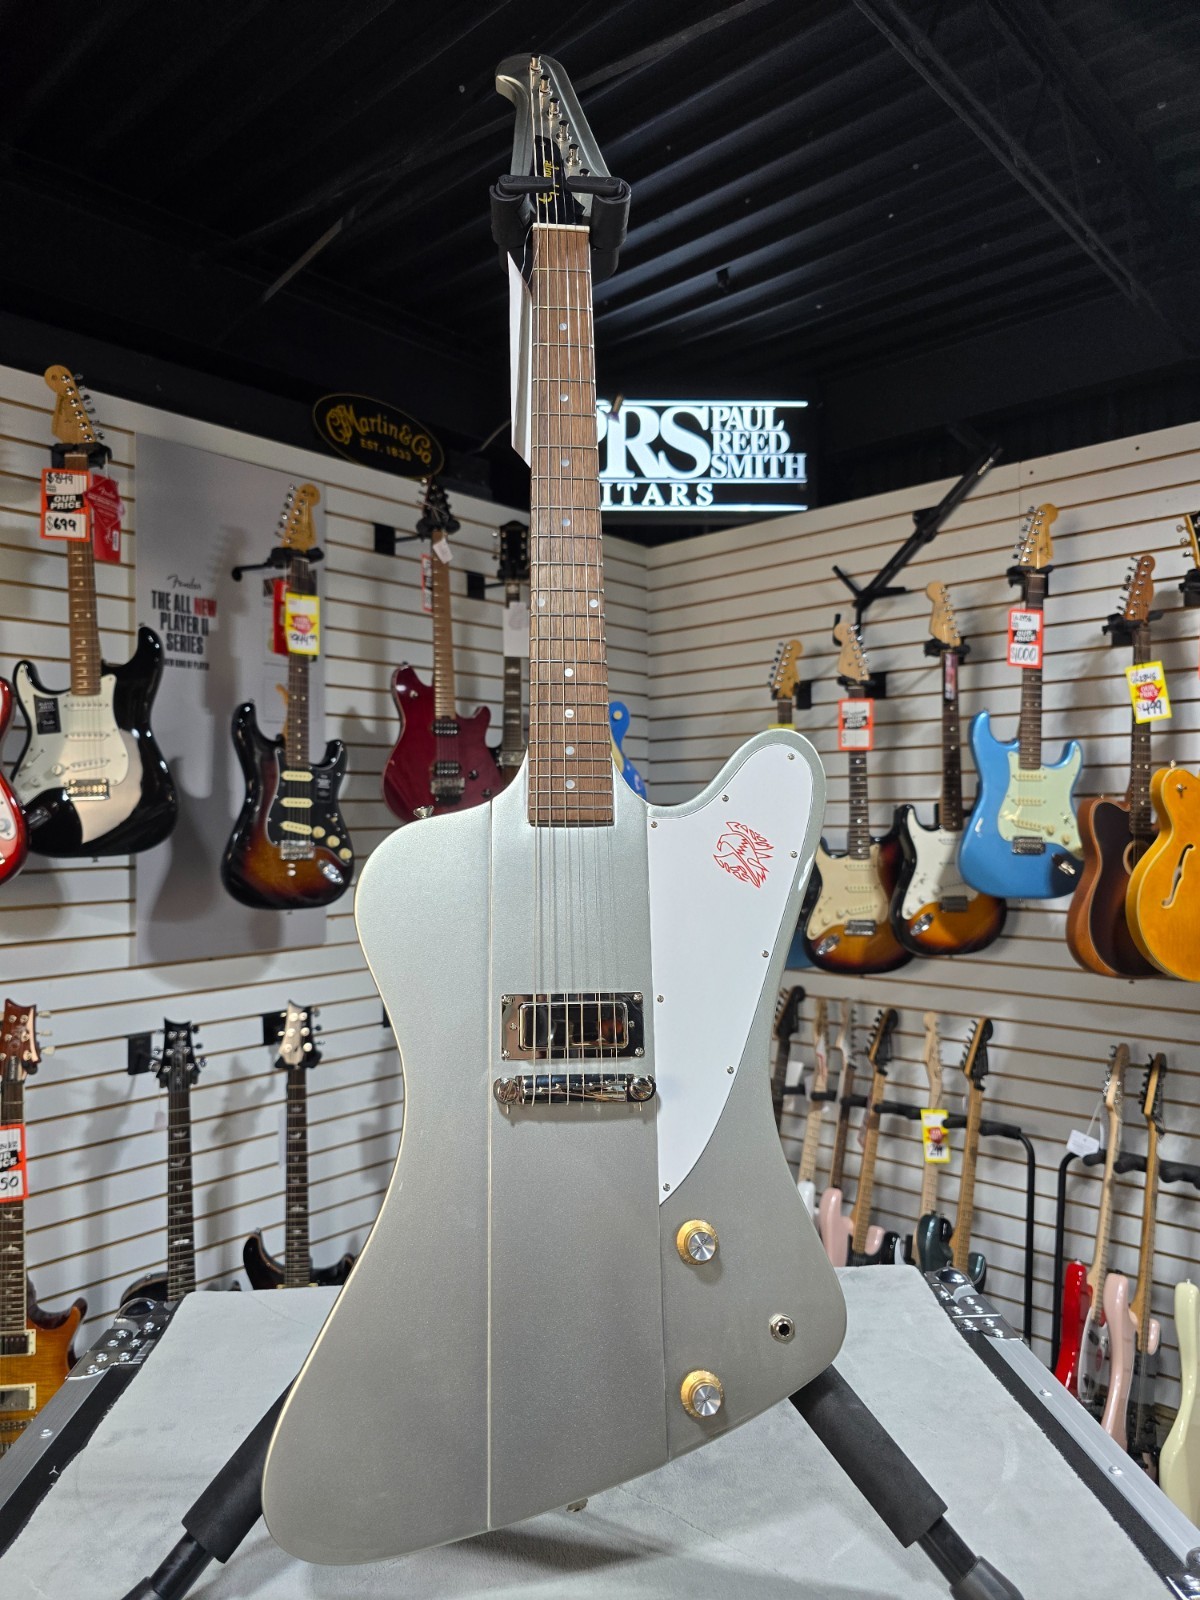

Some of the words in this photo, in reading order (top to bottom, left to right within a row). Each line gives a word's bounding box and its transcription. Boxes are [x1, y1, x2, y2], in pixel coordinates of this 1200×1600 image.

[711, 406, 785, 432] PAUL
[711, 430, 791, 455] REED
[710, 453, 807, 480] SMITH
[49, 502, 82, 510] PRICE
[53, 495, 77, 503] OUR
[601, 482, 714, 507] ITARS
[46, 516, 77, 532] $699
[152, 590, 171, 612] THE
[173, 593, 192, 615] ALL
[160, 611, 200, 635] PLAYER
[166, 632, 204, 655] SERIES
